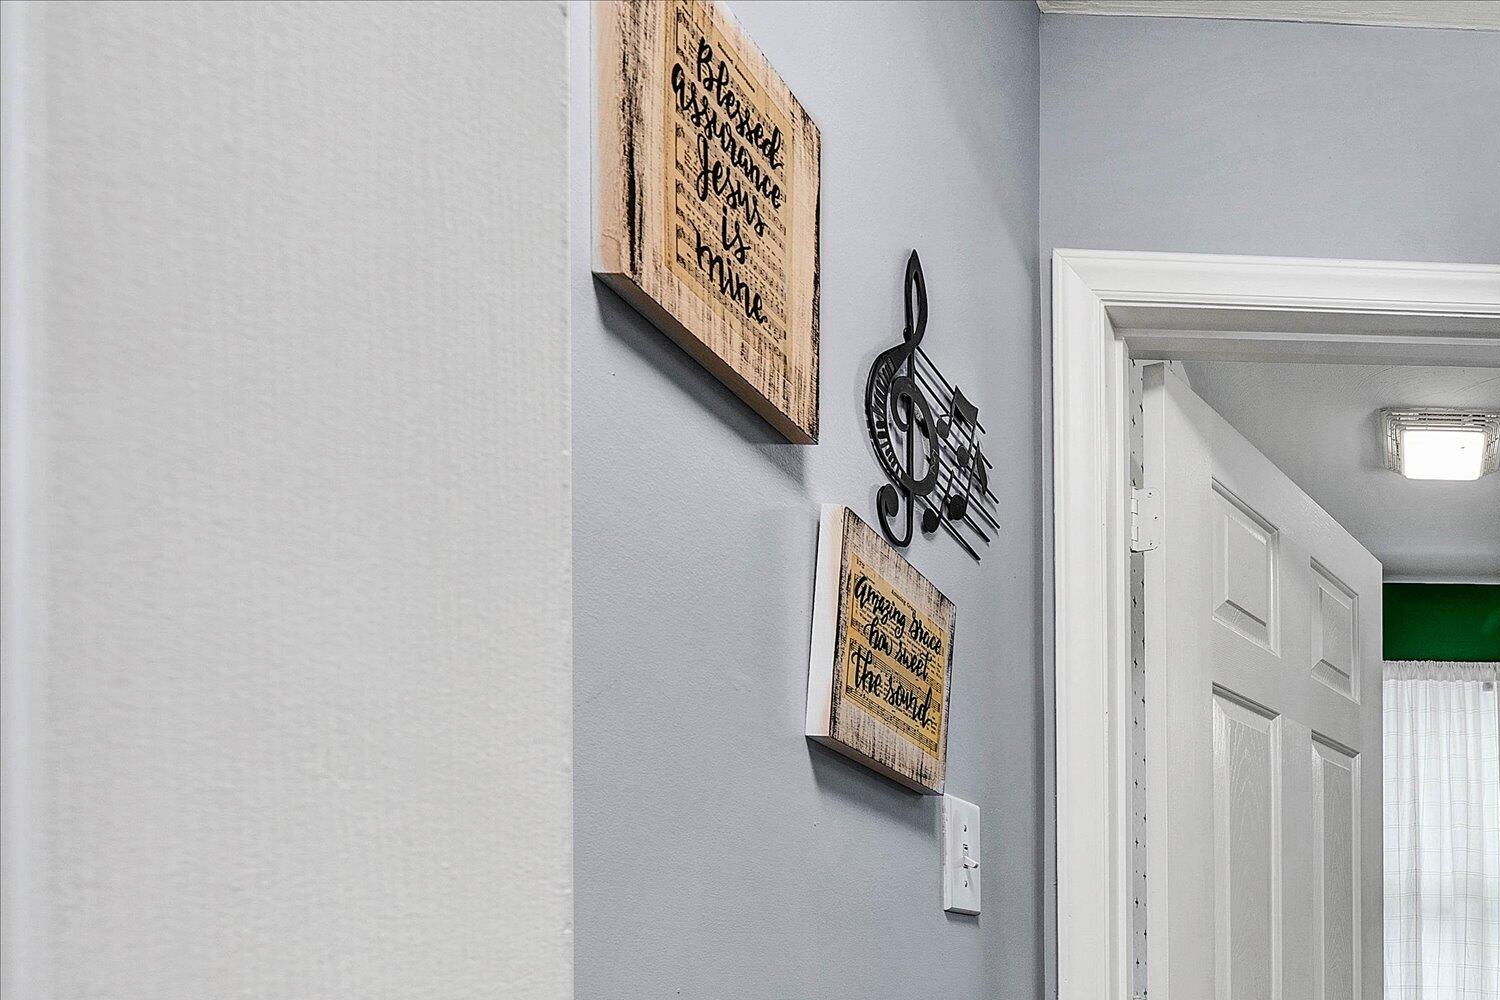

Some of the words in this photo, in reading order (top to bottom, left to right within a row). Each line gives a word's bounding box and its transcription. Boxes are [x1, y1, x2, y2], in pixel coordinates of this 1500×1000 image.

[697, 36, 783, 170] Blessed
[697, 133, 768, 238] Jesus
[721, 203, 751, 265] is
[690, 219, 768, 324] mine
[884, 674, 935, 729] sound
